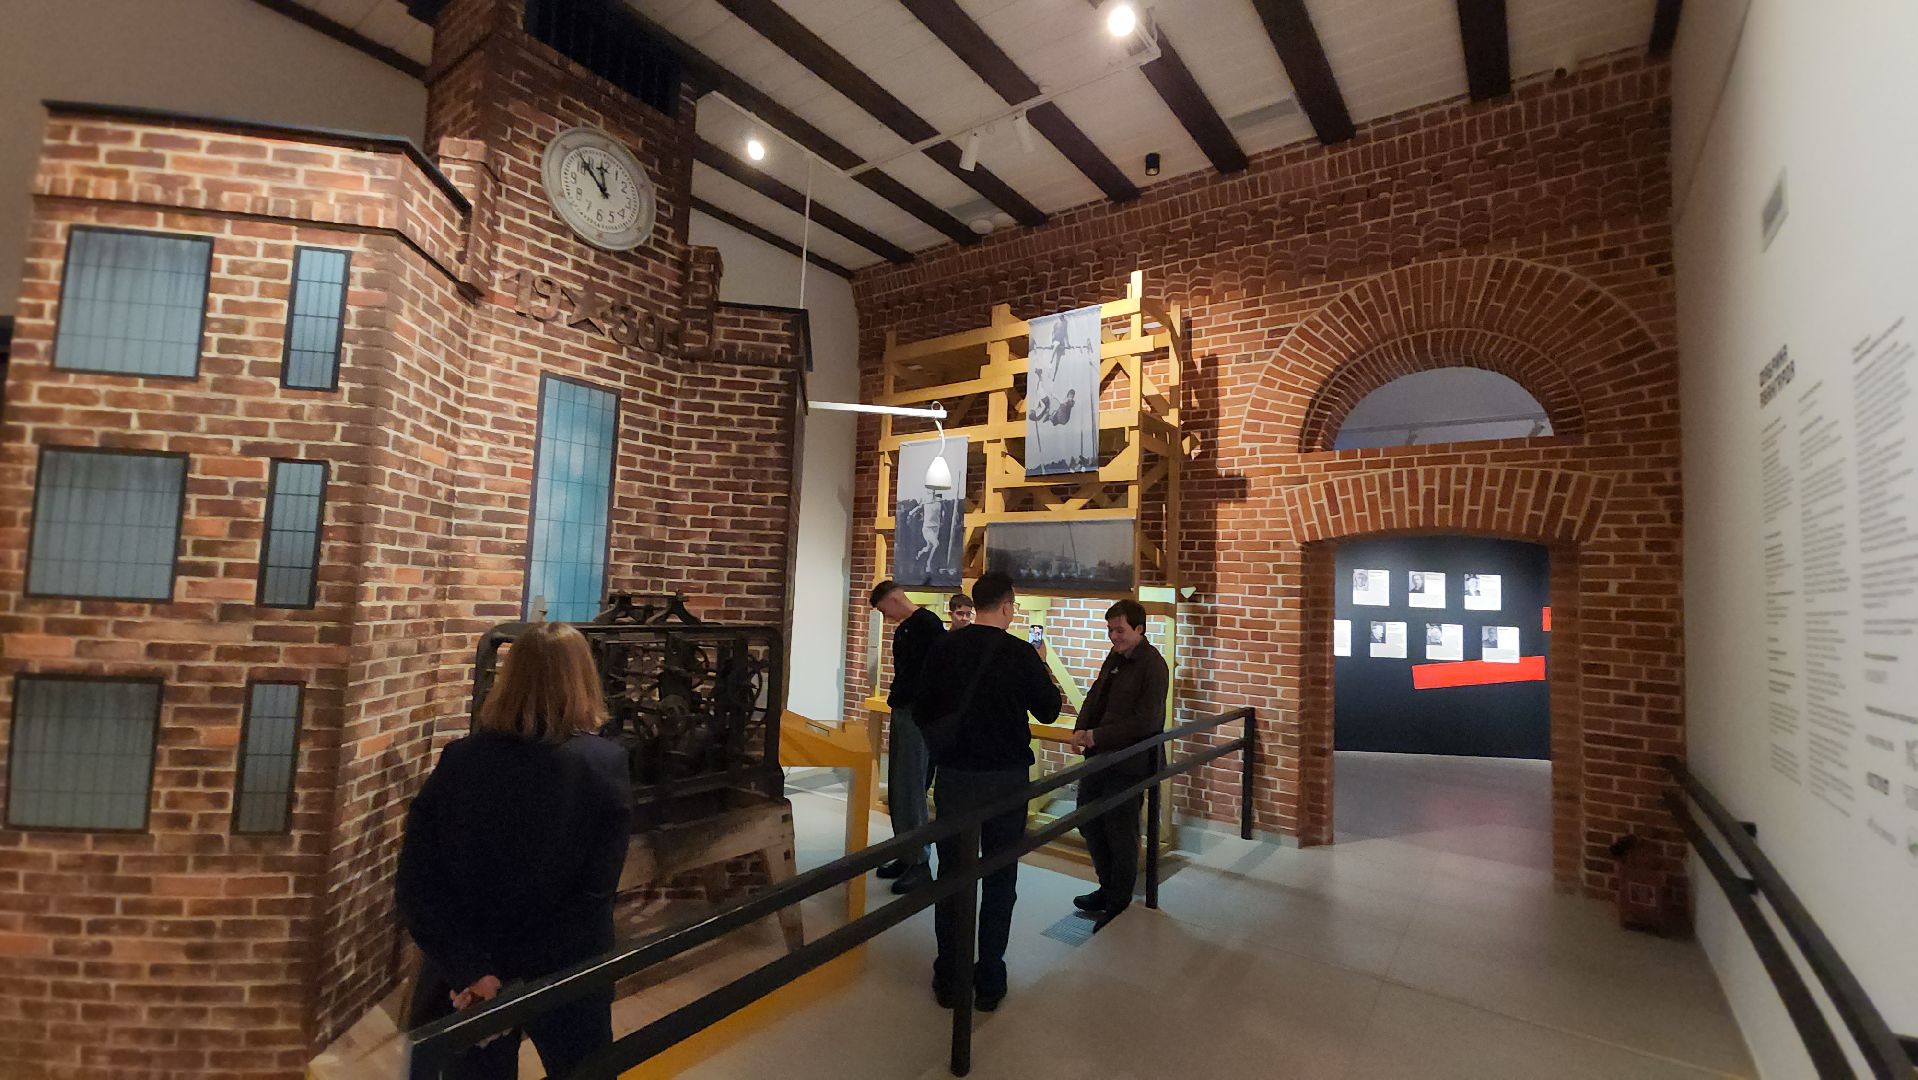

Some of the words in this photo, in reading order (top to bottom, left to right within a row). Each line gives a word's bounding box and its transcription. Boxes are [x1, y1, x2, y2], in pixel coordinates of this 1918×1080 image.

[571, 171, 577, 184] 9
[621, 181, 628, 194] 2
[586, 200, 592, 212] 7
[625, 198, 631, 209] 3
[596, 209, 603, 222] 6
[608, 211, 614, 223] 5
[617, 208, 625, 219] 4
[504, 269, 562, 321] 19
